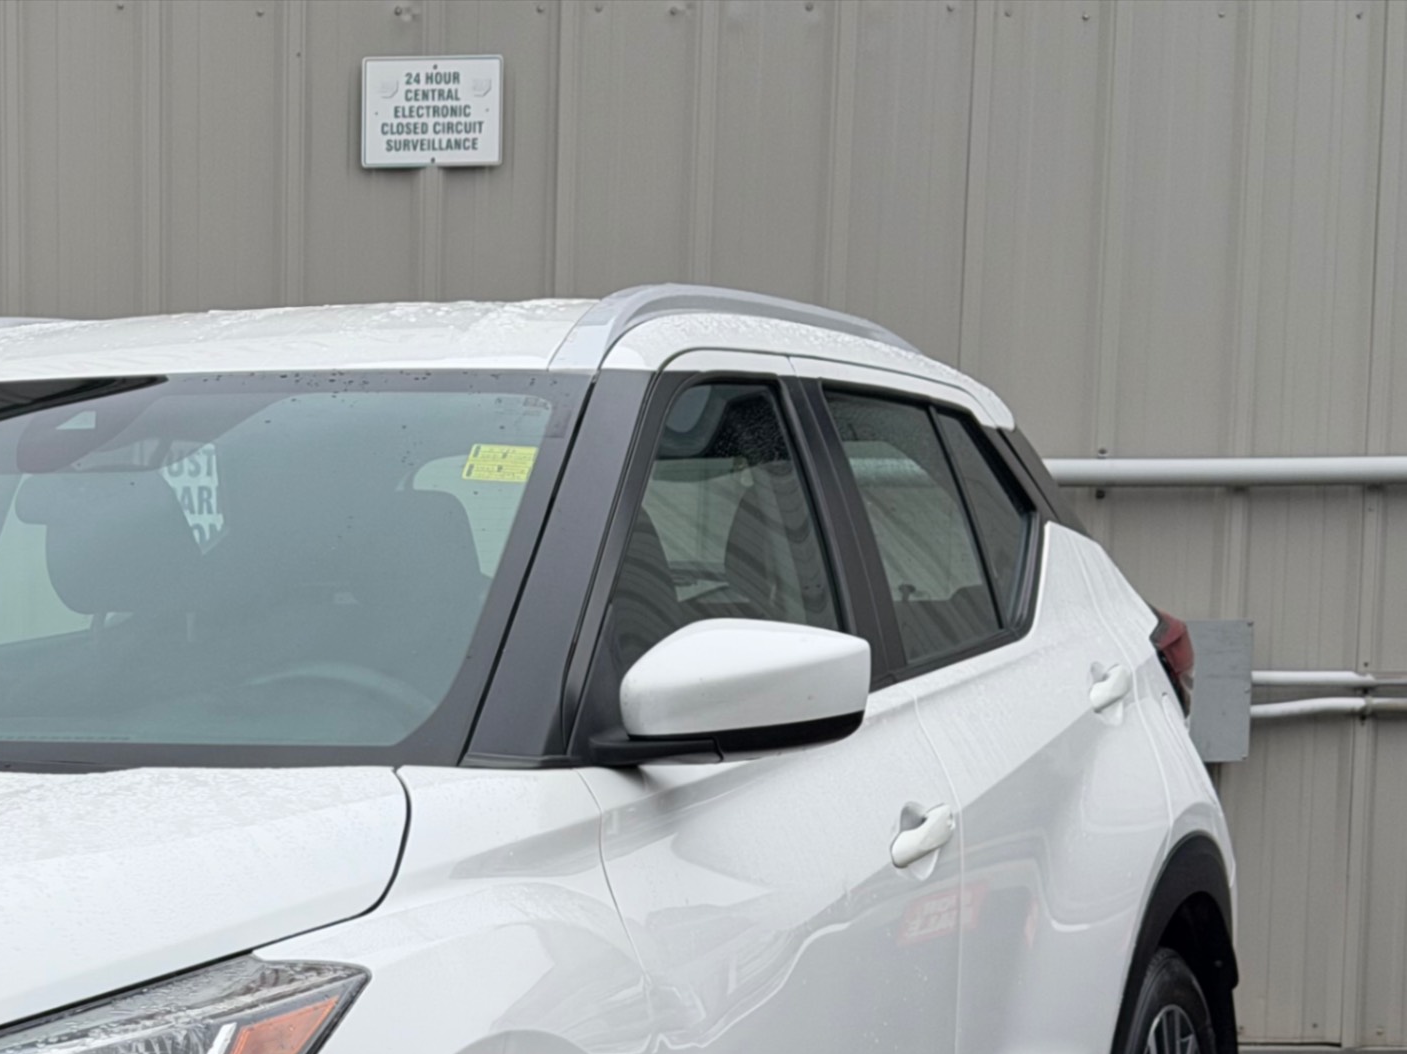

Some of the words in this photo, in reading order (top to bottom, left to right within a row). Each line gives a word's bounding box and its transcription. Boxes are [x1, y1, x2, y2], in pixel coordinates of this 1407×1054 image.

[404, 72, 421, 85] 24
[425, 71, 461, 85] HOUR
[404, 88, 461, 102] CENTRAL
[394, 104, 472, 119] ELECTRONIC
[381, 122, 429, 136] CLOSED
[432, 121, 484, 135] CIRCUIT
[385, 137, 478, 152] SURVEILLANCE
